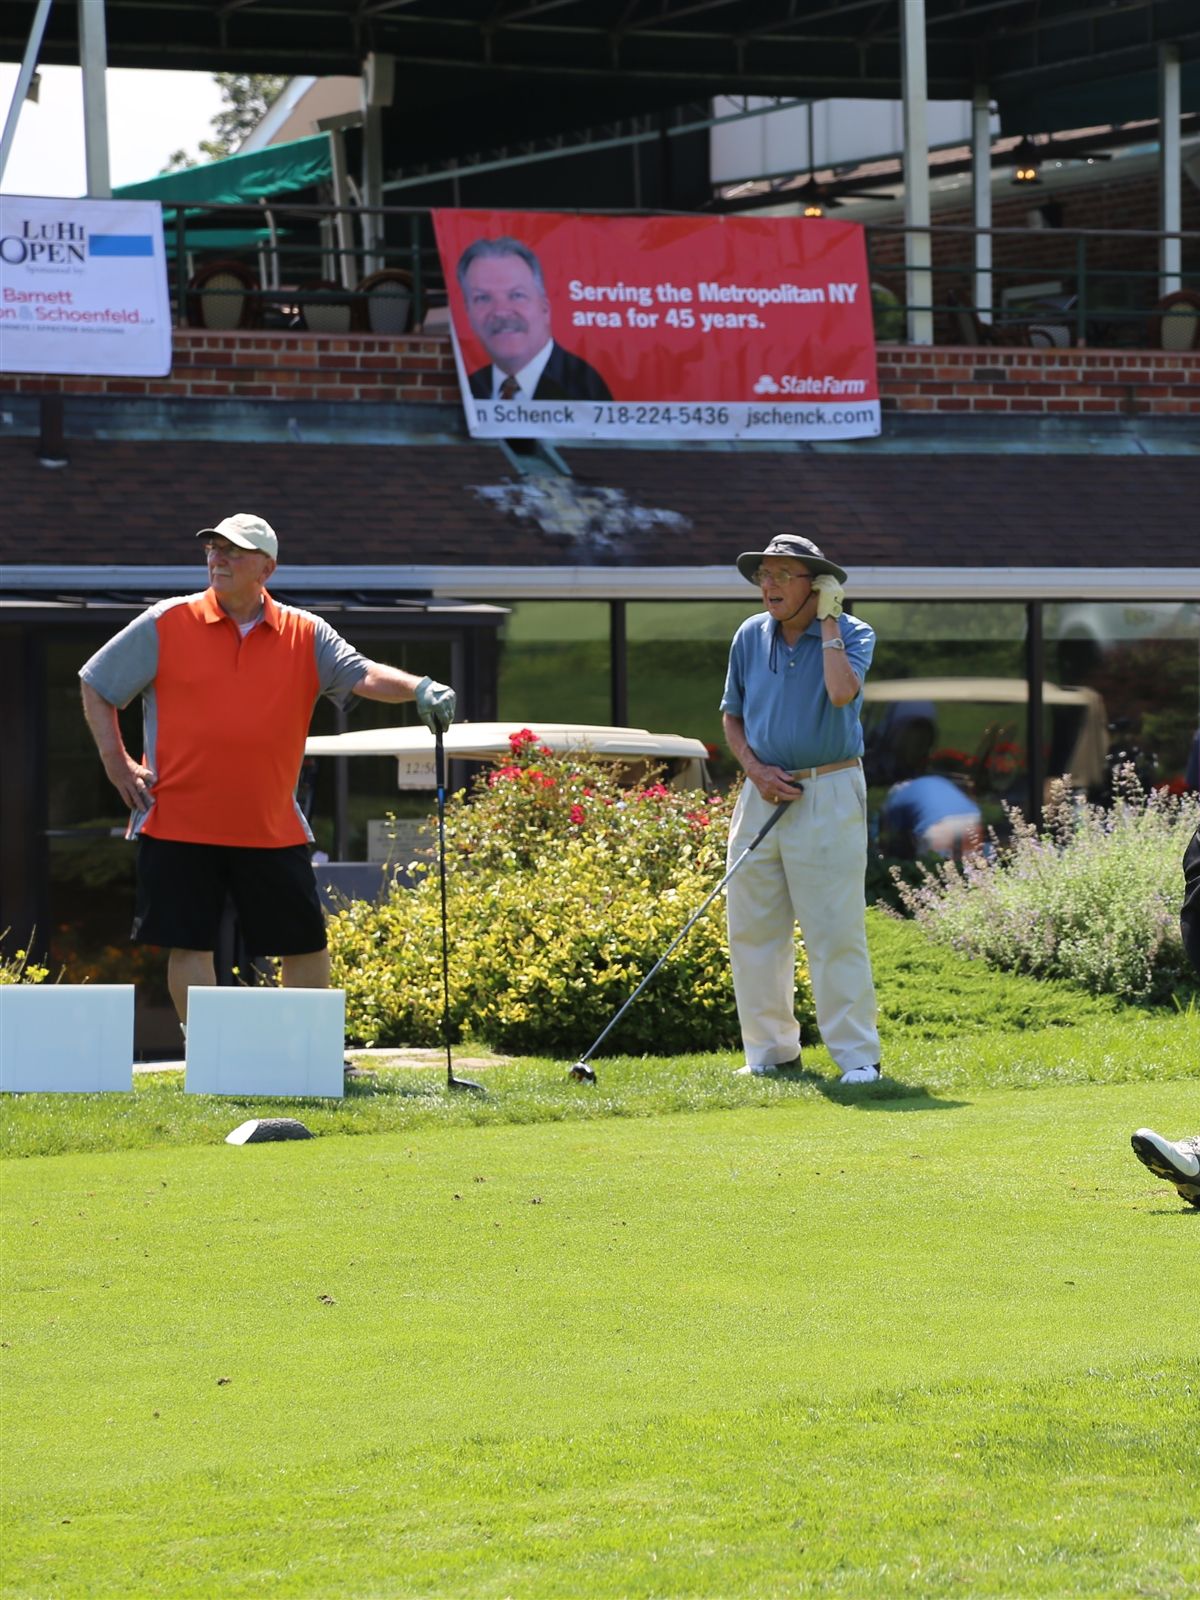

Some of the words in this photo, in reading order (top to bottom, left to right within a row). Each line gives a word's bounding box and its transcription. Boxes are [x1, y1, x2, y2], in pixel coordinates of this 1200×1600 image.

[0, 236, 86, 265] OPEN
[3, 287, 74, 305] Barnett
[568, 280, 654, 307] Serving
[656, 282, 693, 303] the
[698, 282, 825, 308] Metropolitan
[828, 283, 859, 303] NY
[35, 305, 140, 325] Schoenfeld
[572, 310, 622, 328] area
[626, 307, 659, 328] for
[664, 308, 696, 328] 45
[700, 312, 766, 332] years.
[494, 405, 575, 424] Schenck
[594, 405, 730, 425] 718-224-5436
[745, 406, 875, 428] jschenck.com
